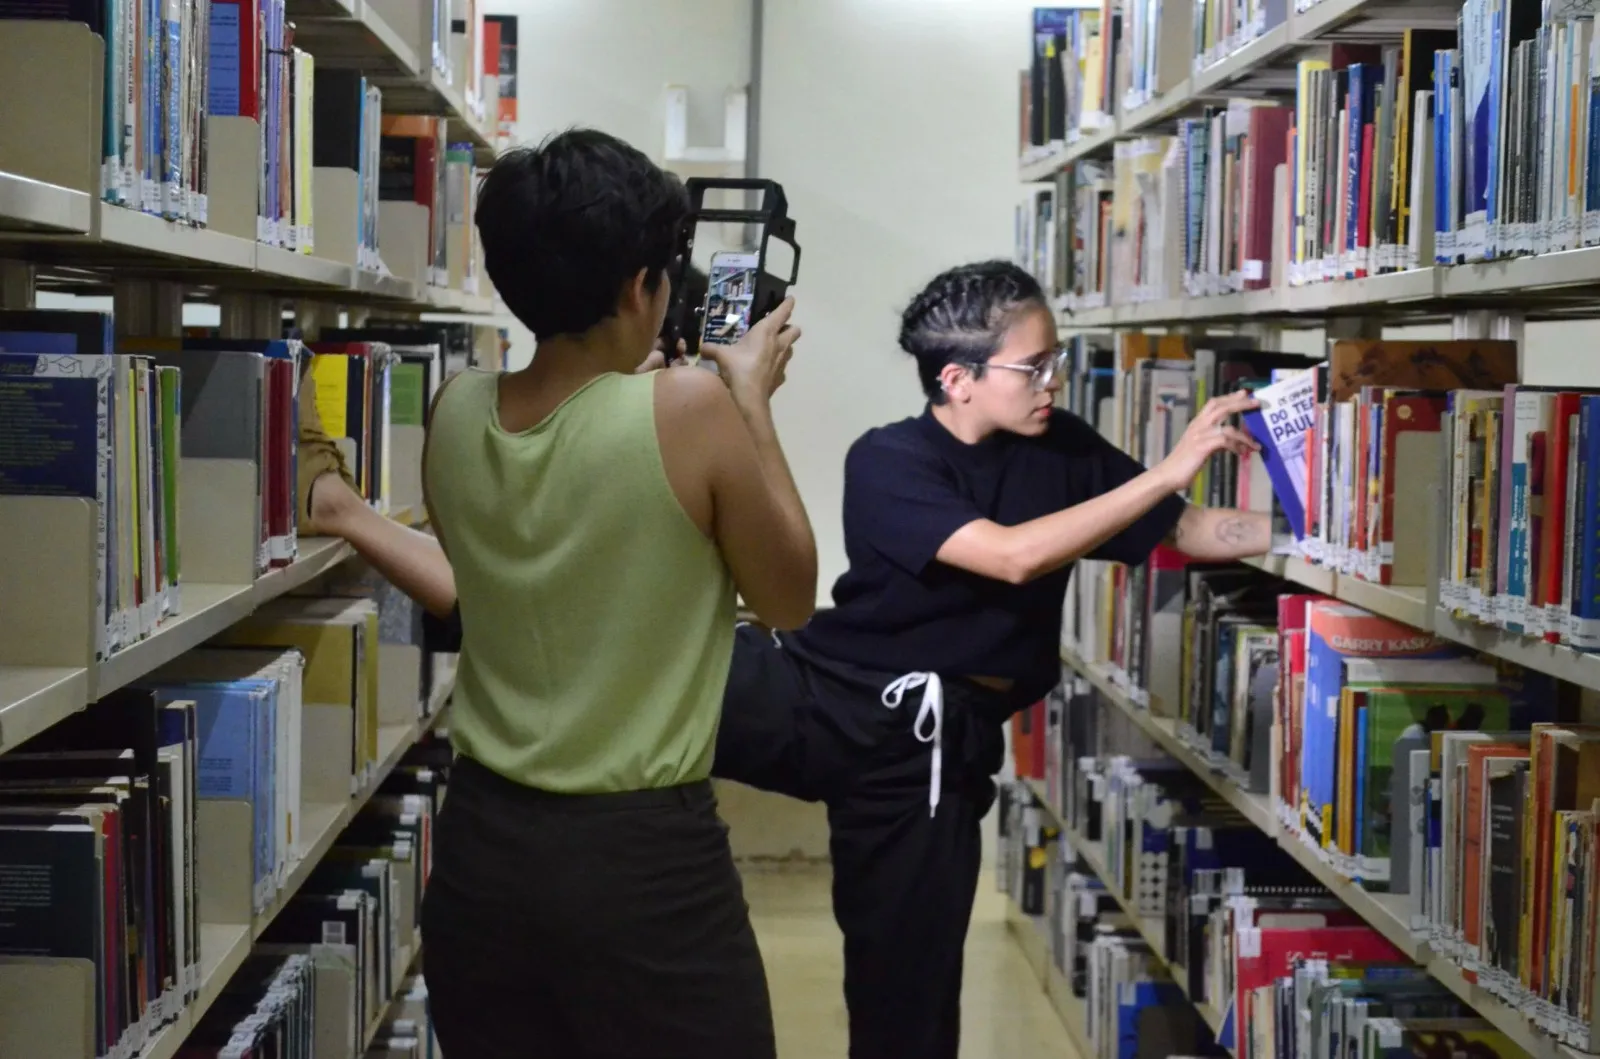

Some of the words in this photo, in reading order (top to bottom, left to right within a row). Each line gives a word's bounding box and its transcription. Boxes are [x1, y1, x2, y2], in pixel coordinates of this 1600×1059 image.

[1270, 409, 1288, 425] DO
[1273, 414, 1314, 442] PAUL
[1332, 635, 1383, 652] GARRY
[1388, 637, 1436, 652] KASP
